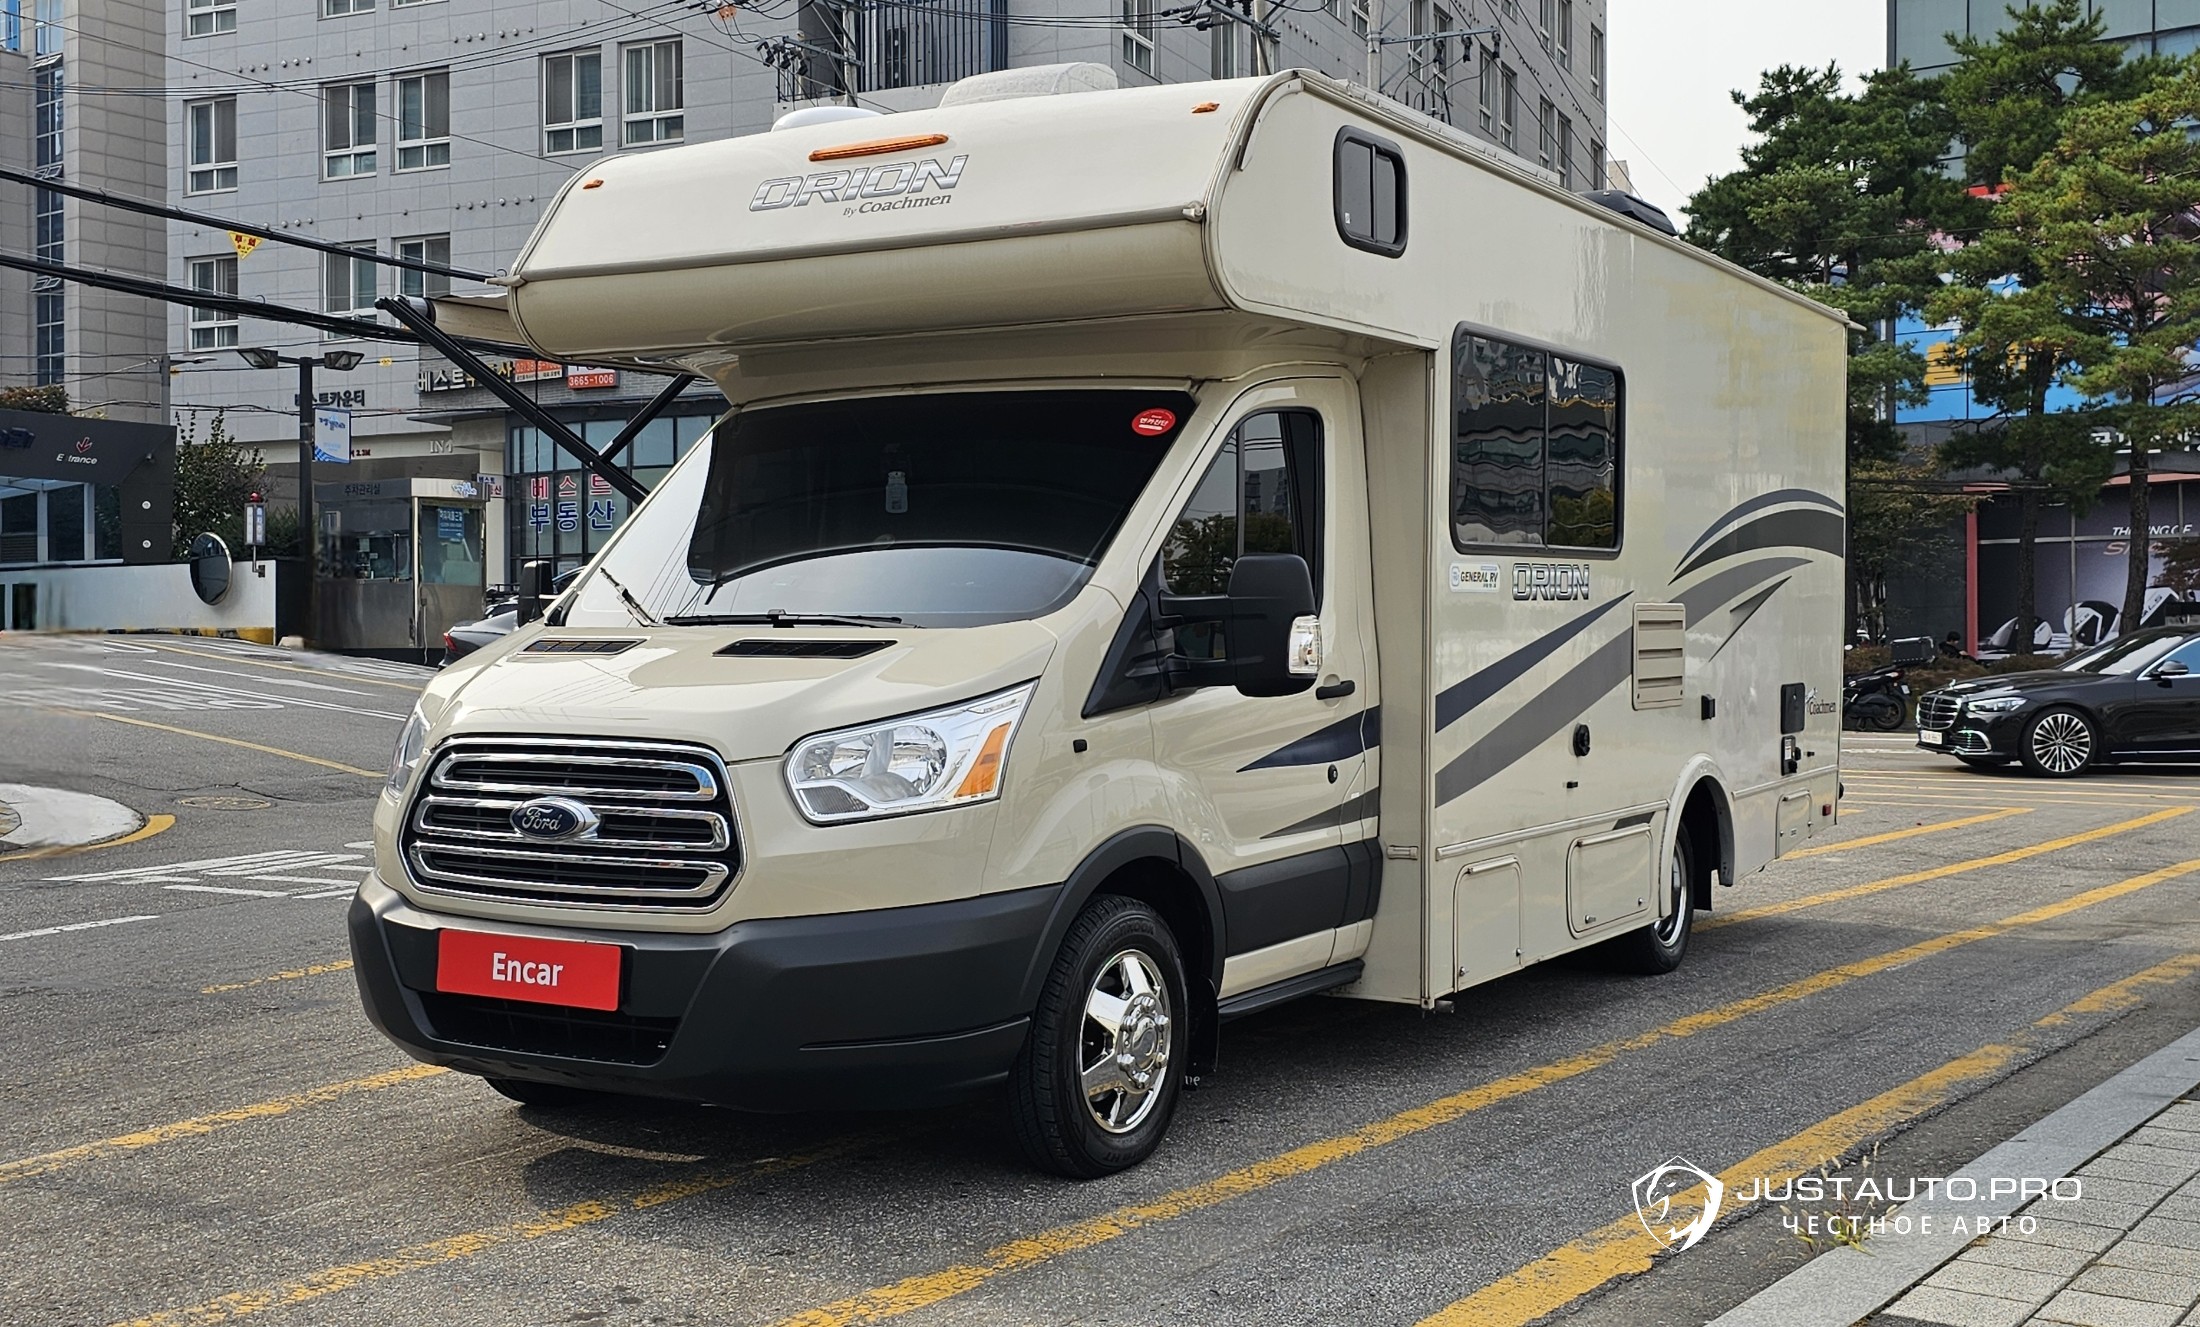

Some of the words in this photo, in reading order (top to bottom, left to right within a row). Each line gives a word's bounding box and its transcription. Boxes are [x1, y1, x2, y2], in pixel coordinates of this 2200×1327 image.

[749, 154, 969, 212] ORION
[843, 207, 857, 218] By
[859, 193, 952, 214] Coachmen
[417, 369, 467, 392] 베스트
[568, 374, 614, 387] 3665-1006
[294, 389, 365, 408] 트카운티
[344, 483, 381, 497] 주차관리실
[530, 473, 613, 500] 베스트
[529, 499, 616, 534] 부동산
[1460, 571, 1488, 583] GENERAL
[1489, 572, 1499, 583] RV
[1512, 562, 1589, 601] ORION
[1809, 699, 1836, 715] Coachmen
[522, 806, 563, 831] Ford
[492, 952, 564, 987] Encar
